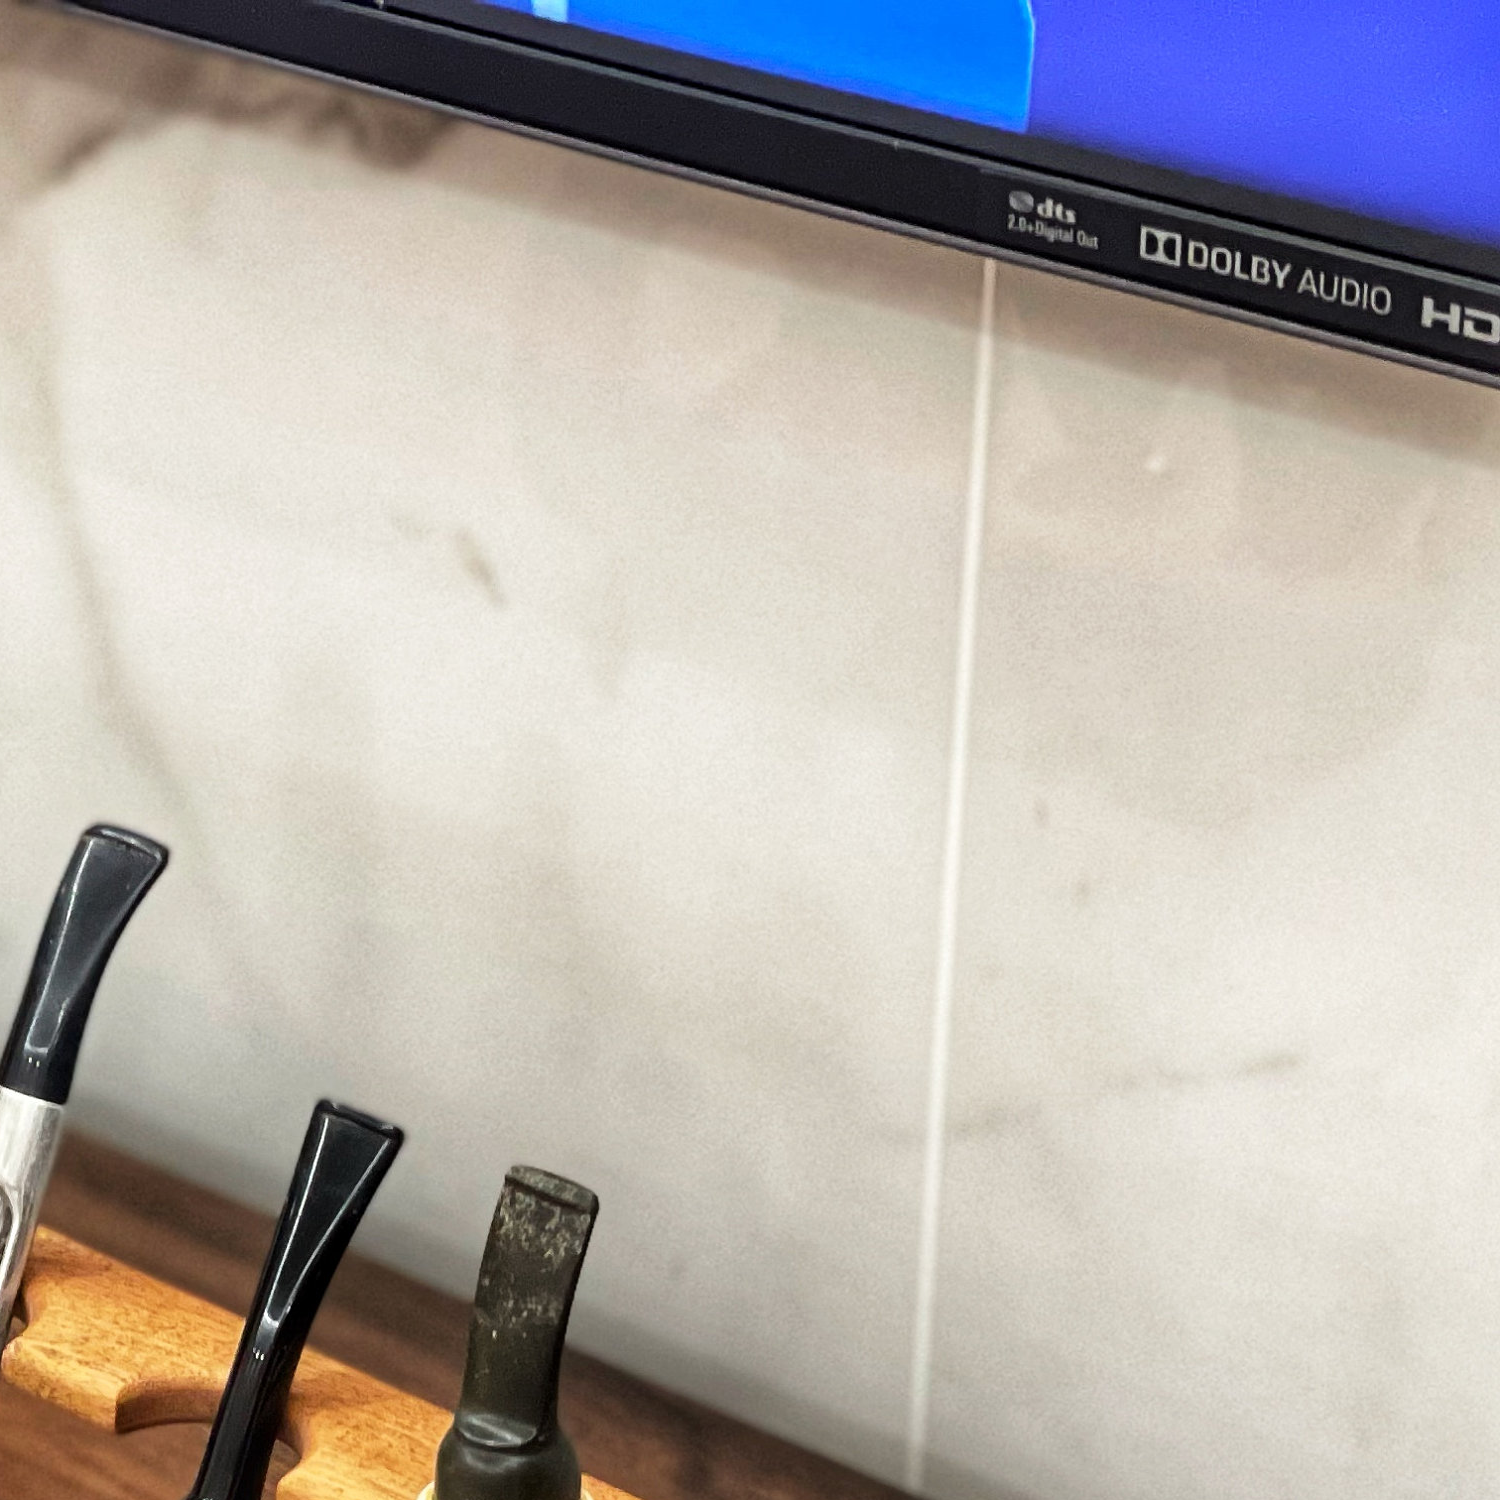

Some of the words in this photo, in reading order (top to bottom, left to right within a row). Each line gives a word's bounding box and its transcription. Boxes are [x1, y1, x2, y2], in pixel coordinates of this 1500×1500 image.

[1037, 196, 1077, 225] dts
[1076, 229, 1100, 250] Out
[1187, 239, 1292, 290] DOLBY
[1297, 267, 1393, 316] AUDIO
